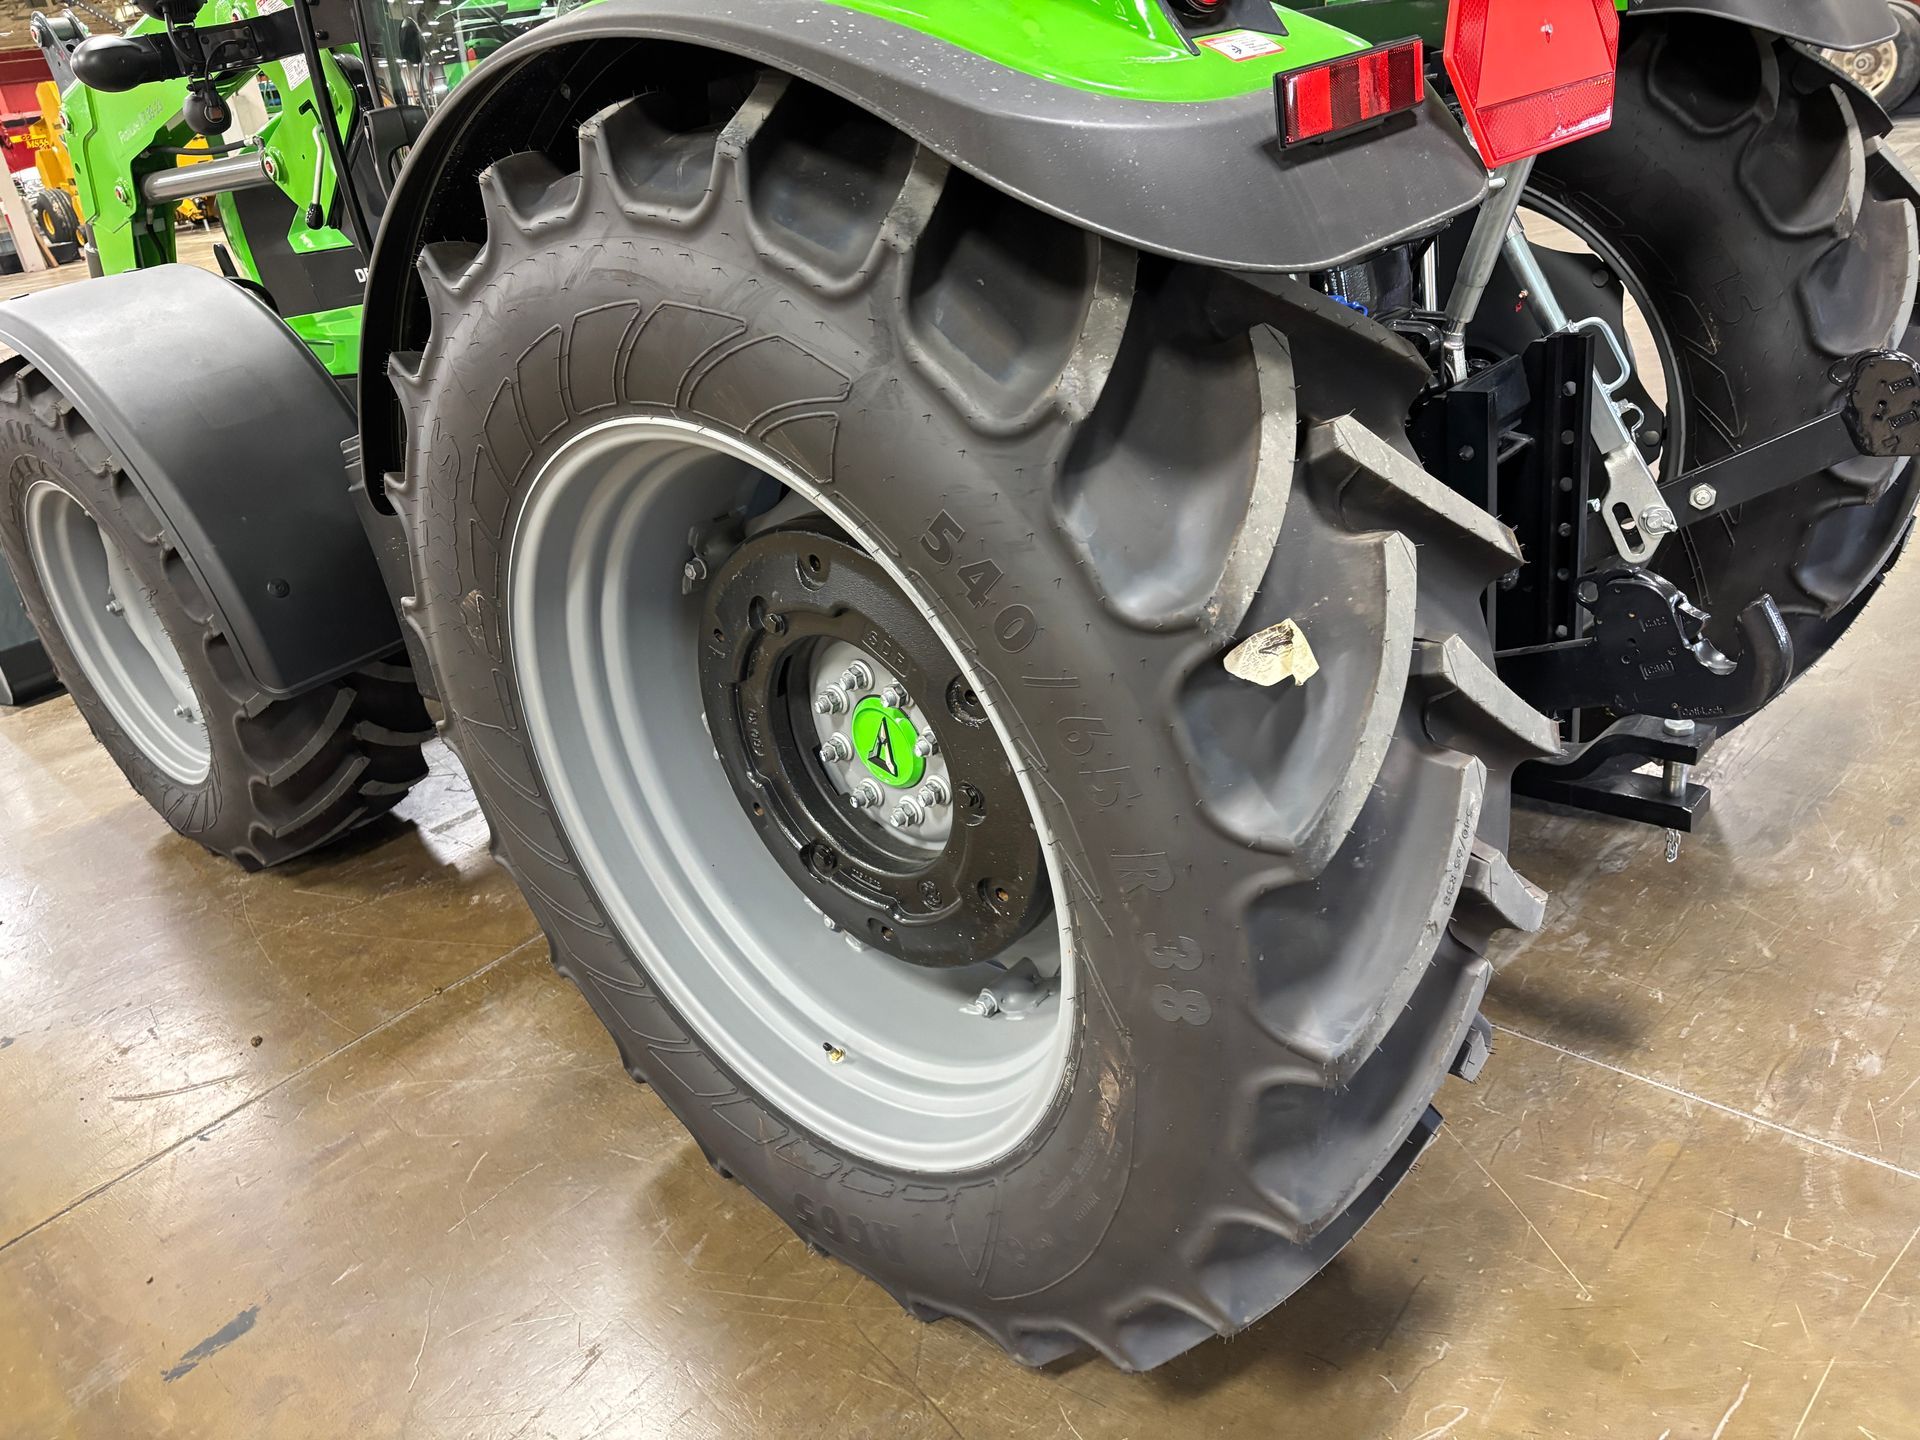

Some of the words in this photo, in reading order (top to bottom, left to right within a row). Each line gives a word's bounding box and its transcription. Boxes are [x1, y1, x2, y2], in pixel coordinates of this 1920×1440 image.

[919, 508, 1143, 810] 540/65
[1110, 849, 1176, 894] R
[1143, 931, 1213, 1027] 38
